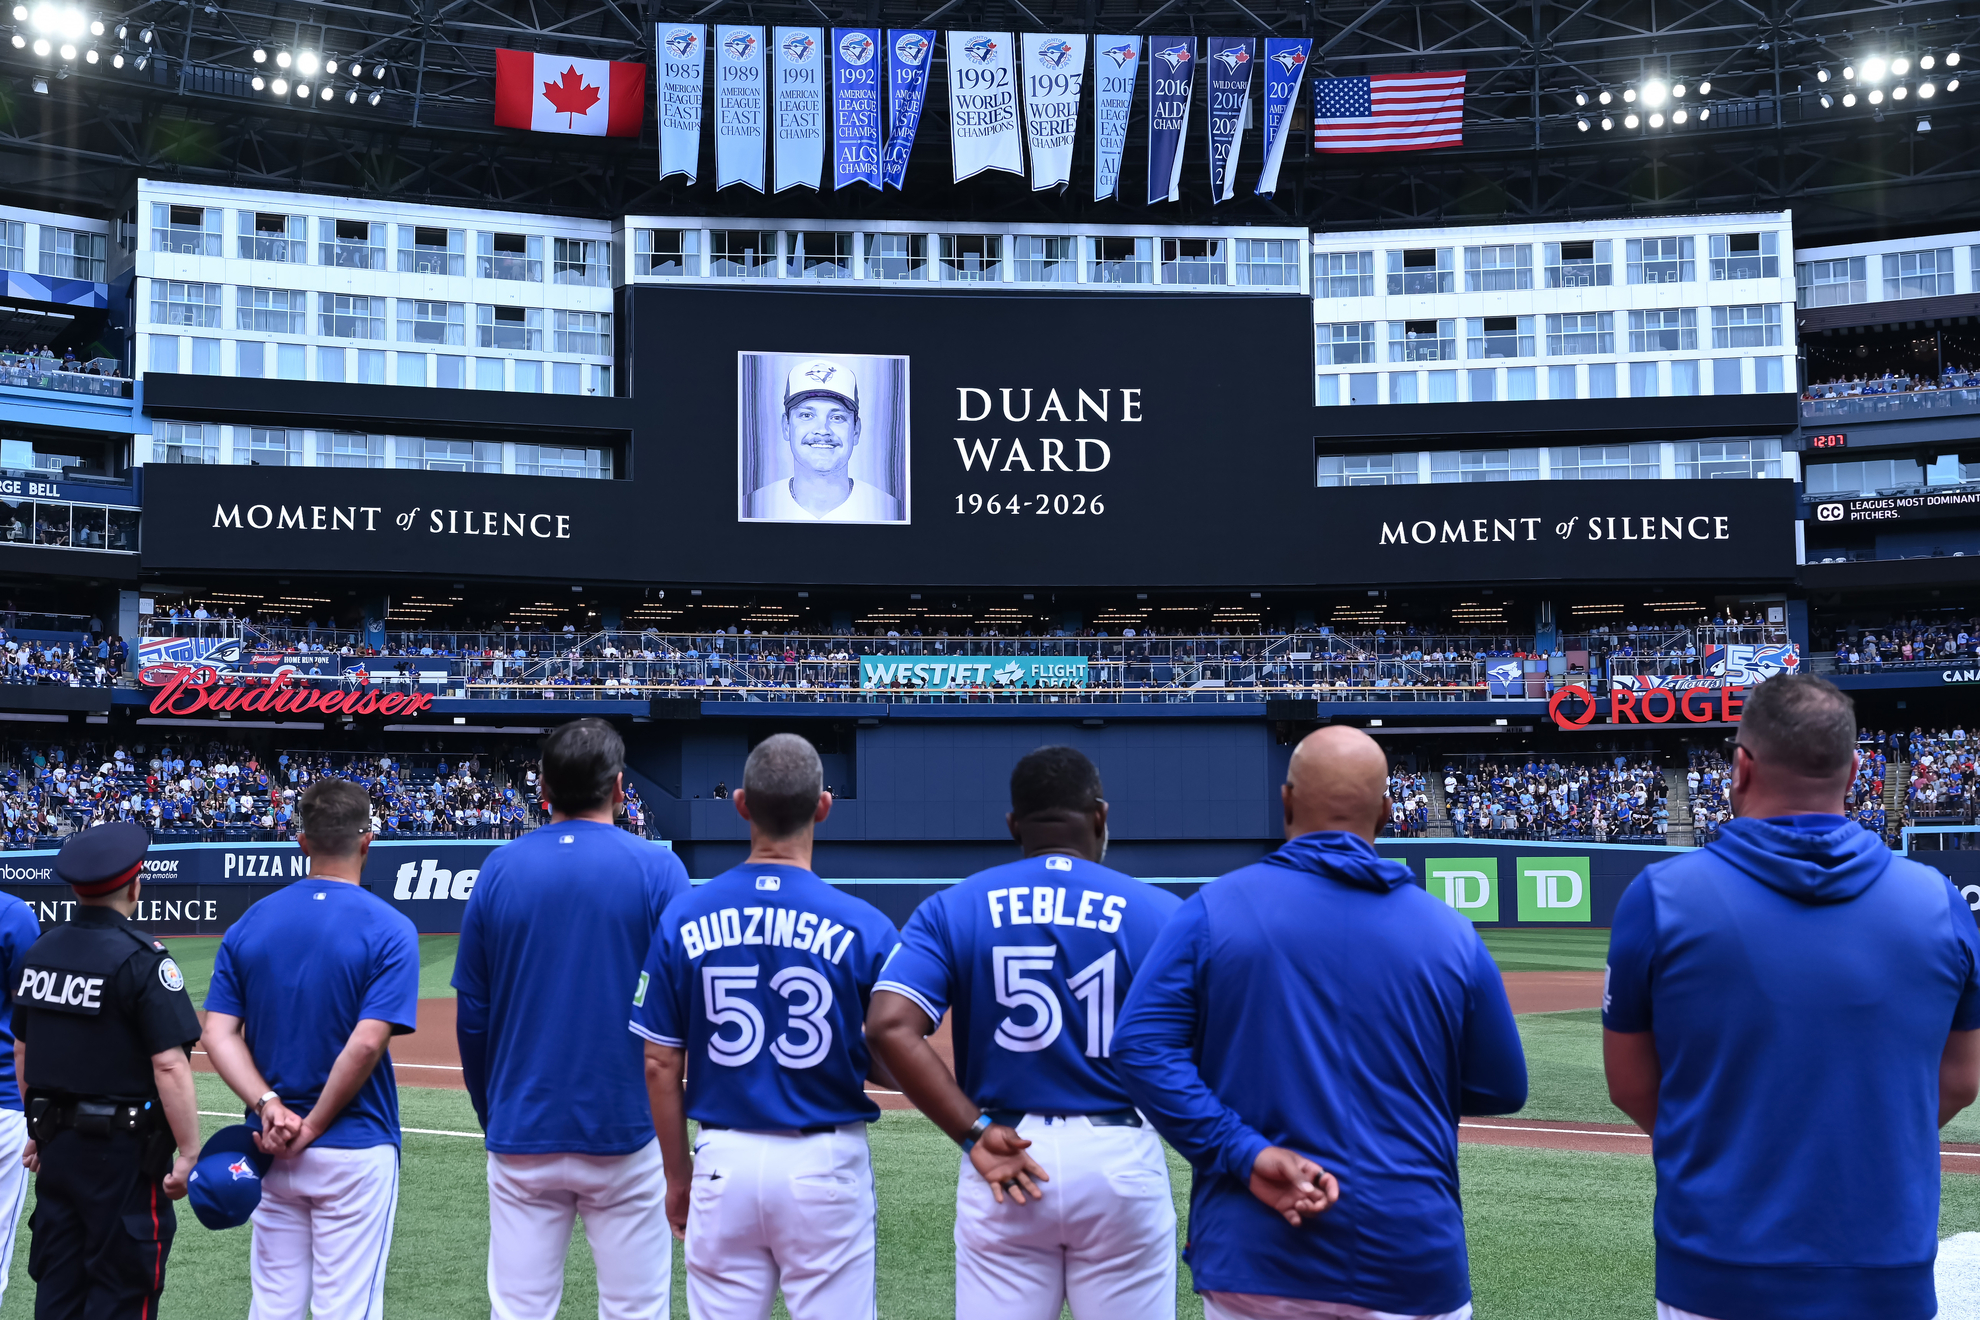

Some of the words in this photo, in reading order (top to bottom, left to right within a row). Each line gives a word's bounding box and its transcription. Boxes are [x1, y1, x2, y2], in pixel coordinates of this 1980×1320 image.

[666, 63, 700, 79] 1985
[722, 66, 758, 82] 1989
[783, 68, 815, 84] 1991
[840, 68, 874, 84] 1992
[956, 68, 1009, 90] 1992
[664, 82, 701, 93] AMERICAN
[721, 88, 760, 96] AMERICAN
[1030, 74, 1082, 98] 1993
[1156, 78, 1189, 96] 2016
[1213, 80, 1230, 89] WILD
[664, 92, 702, 105] LEAGUE
[780, 90, 818, 99] AMERICAN
[838, 90, 876, 100] AMERICAN
[956, 91, 1012, 110] WORLD
[721, 98, 760, 109] LEAGUE
[780, 101, 819, 111] LEAGUE
[839, 100, 876, 112] LEAGUE
[1101, 99, 1129, 108] AMERIC
[664, 104, 701, 120] EAST
[722, 110, 760, 124] EAST
[840, 112, 876, 126] EAST
[956, 106, 1013, 126] SERIES
[1101, 110, 1128, 120] LEAG
[664, 118, 700, 132] CHAMPS
[780, 114, 819, 127] EAST
[1030, 118, 1076, 136] SERIE
[1154, 119, 1182, 130] CHAM
[1212, 118, 1238, 134] 202
[721, 126, 760, 136] CHAMPS
[780, 128, 820, 140] CHAMPS
[840, 127, 876, 138] CHAMPS
[957, 121, 1014, 138] CHAMPIONS
[1101, 122, 1126, 136] EAS
[1031, 134, 1074, 148] CHAMPIO
[840, 146, 878, 162] ALCS
[840, 164, 878, 174] CHAMPS
[1101, 158, 1118, 174] AL
[956, 387, 1142, 423] DUANE
[1814, 434, 1844, 447] 12:07
[954, 438, 1112, 473] WARD
[29, 482, 60, 497] BELL
[955, 493, 1105, 516] 1964-2026
[1850, 499, 1894, 510] LEAGUES
[1897, 498, 1924, 506] MOST
[1928, 494, 1980, 505] DOMINANT
[1819, 505, 1842, 520] CC
[1851, 510, 1900, 520] PITCHERS.
[212, 504, 382, 531] MOMENT
[396, 507, 420, 531] of
[430, 508, 570, 539] SILENCE
[1379, 517, 1542, 545] MOMENT
[1556, 516, 1578, 540] of
[1588, 516, 1730, 541] SILENCE
[864, 663, 991, 690] WESTJET
[1032, 664, 1086, 677] FLIGHT
[139, 666, 433, 715] Budweiser
[1611, 687, 1744, 723] ROGE
[141, 860, 179, 872] KOOK
[224, 853, 284, 878] PIZZA
[394, 860, 480, 900] the
[1432, 870, 1490, 908] TD
[1524, 870, 1582, 908] TD
[127, 900, 218, 921] LENCE
[987, 886, 1128, 934] FEBLES
[680, 906, 854, 964] BUDZINSKI
[18, 968, 104, 1008] POLICE
[992, 944, 1117, 1058] 51
[702, 964, 834, 1068] 53
